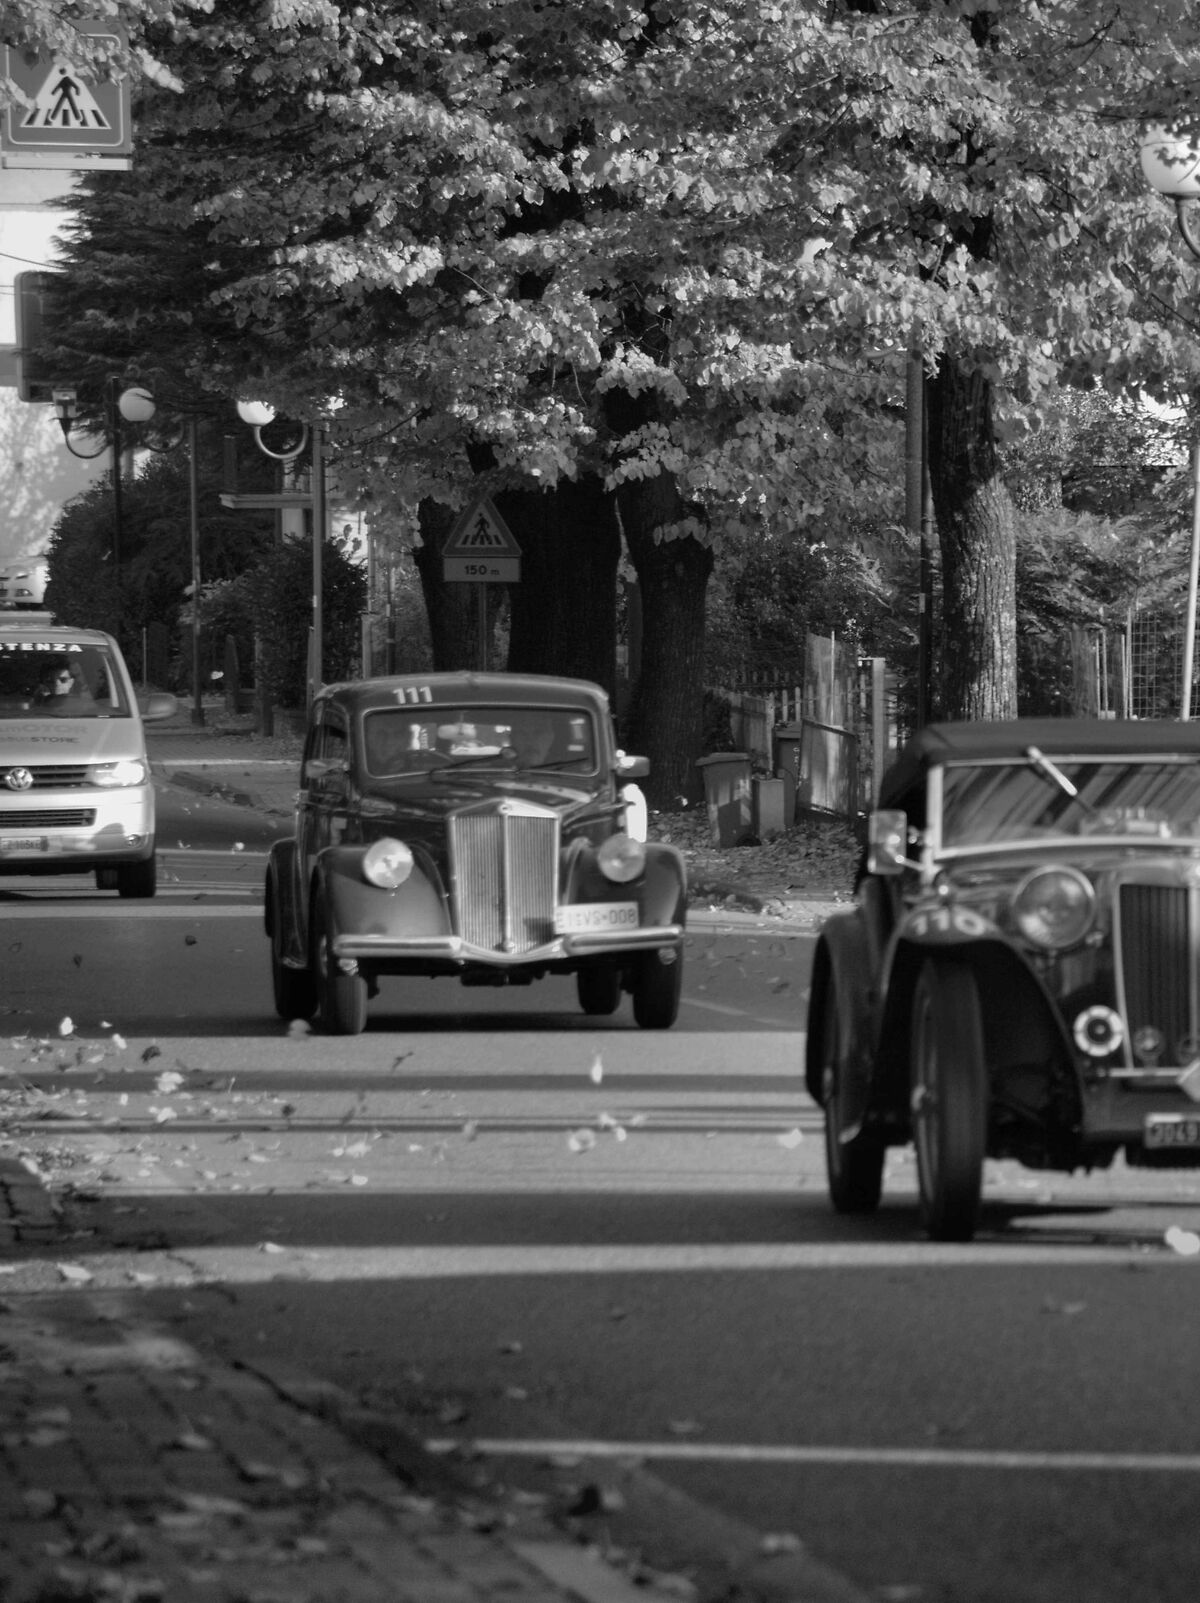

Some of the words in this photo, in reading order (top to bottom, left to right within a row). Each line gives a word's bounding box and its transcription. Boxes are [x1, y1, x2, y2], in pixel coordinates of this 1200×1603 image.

[464, 564, 488, 576] 150
[392, 686, 433, 705] 111
[912, 907, 986, 936] 110
